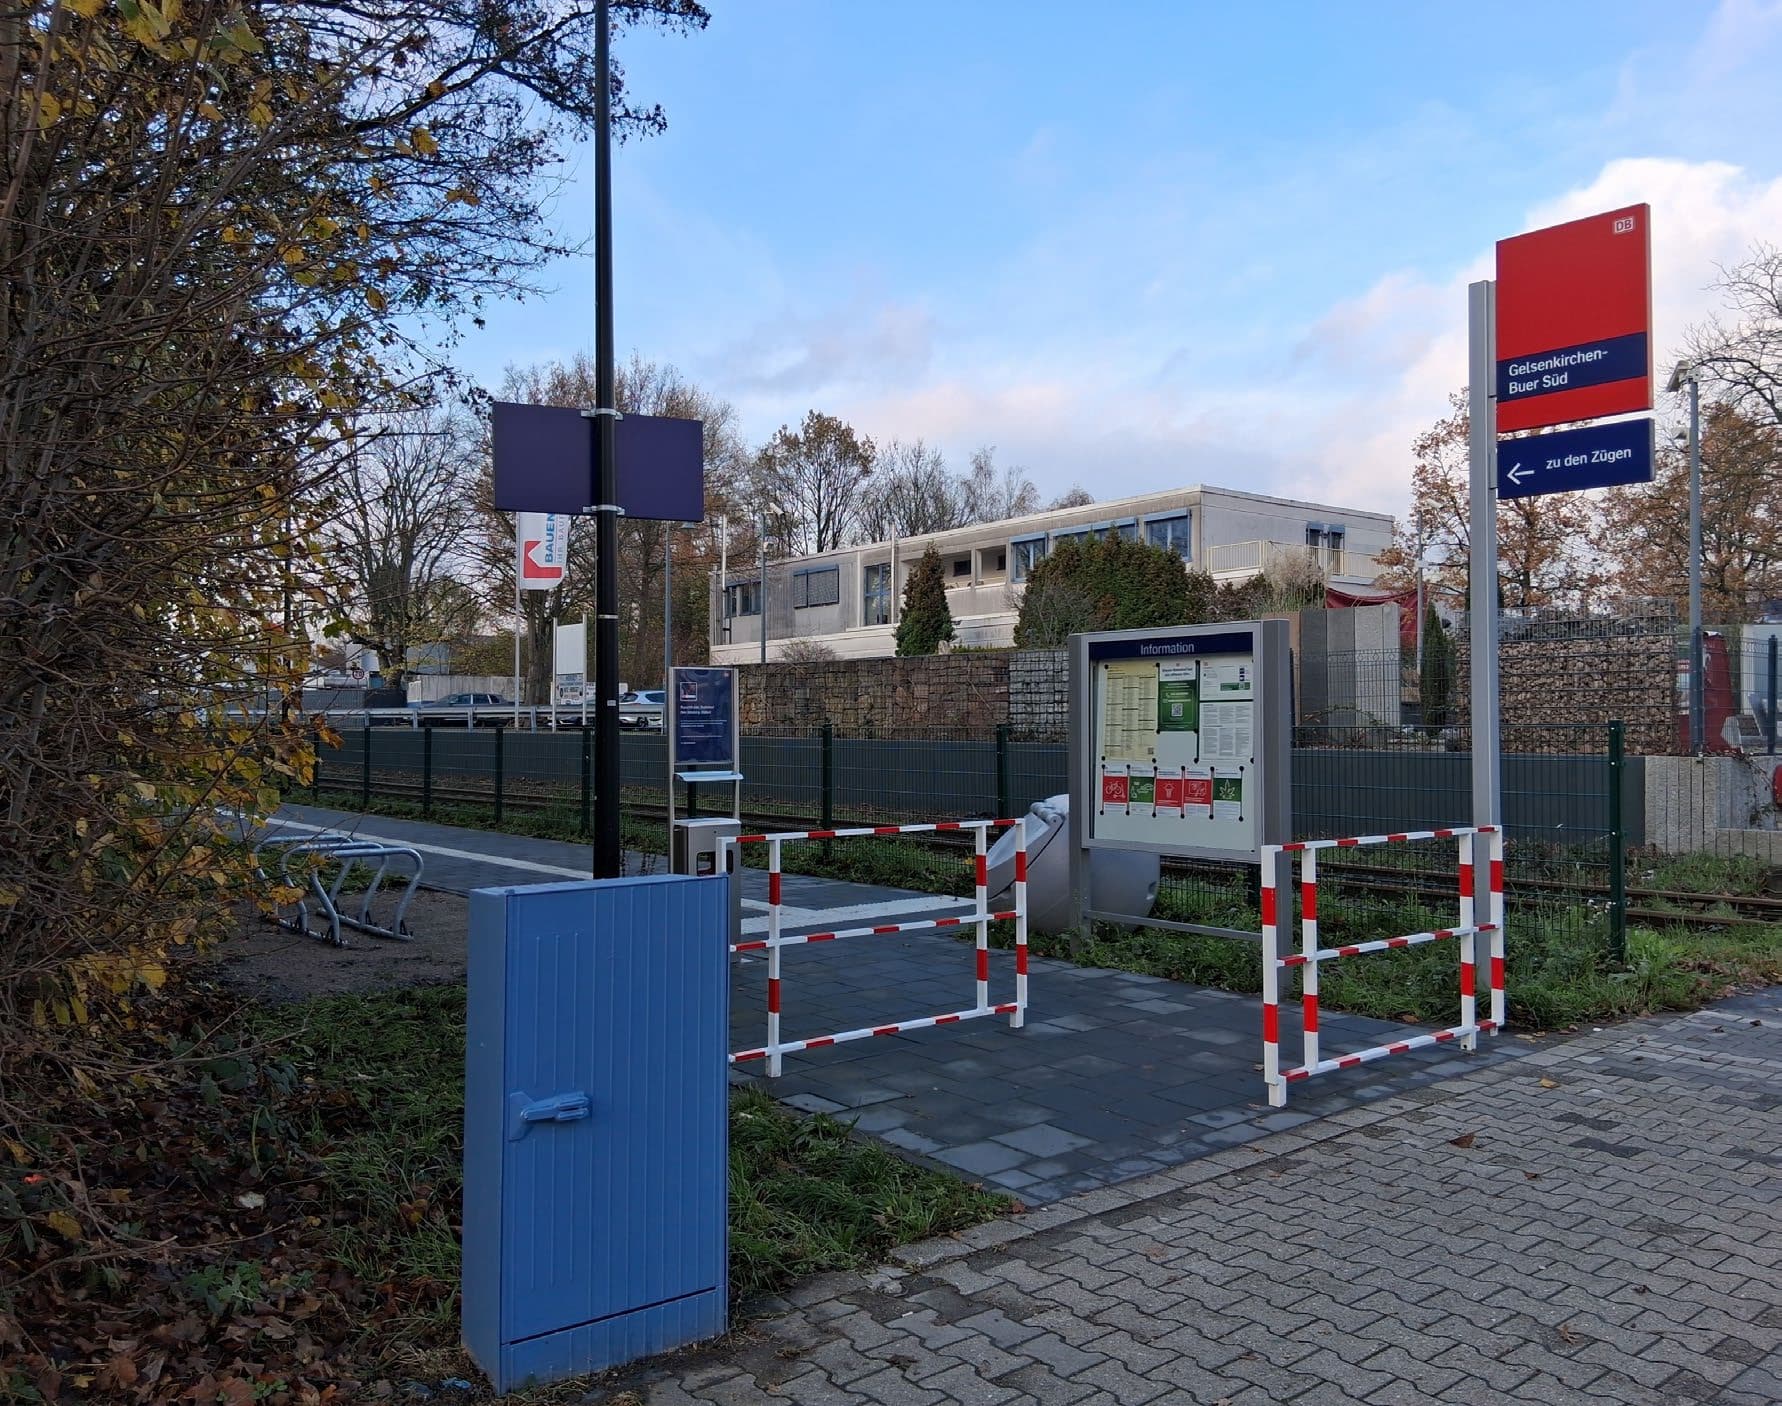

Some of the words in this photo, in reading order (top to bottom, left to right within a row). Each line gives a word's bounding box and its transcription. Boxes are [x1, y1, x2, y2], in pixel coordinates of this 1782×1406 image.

[1615, 218, 1633, 233] DB
[1508, 350, 1608, 377] Gelsenkirchen-
[1508, 380, 1539, 394] Buer
[1542, 372, 1568, 388] Süd
[1546, 458, 1560, 470] zu
[1564, 454, 1587, 466] den
[1591, 448, 1632, 464] Zügen
[1140, 642, 1195, 656] Information
